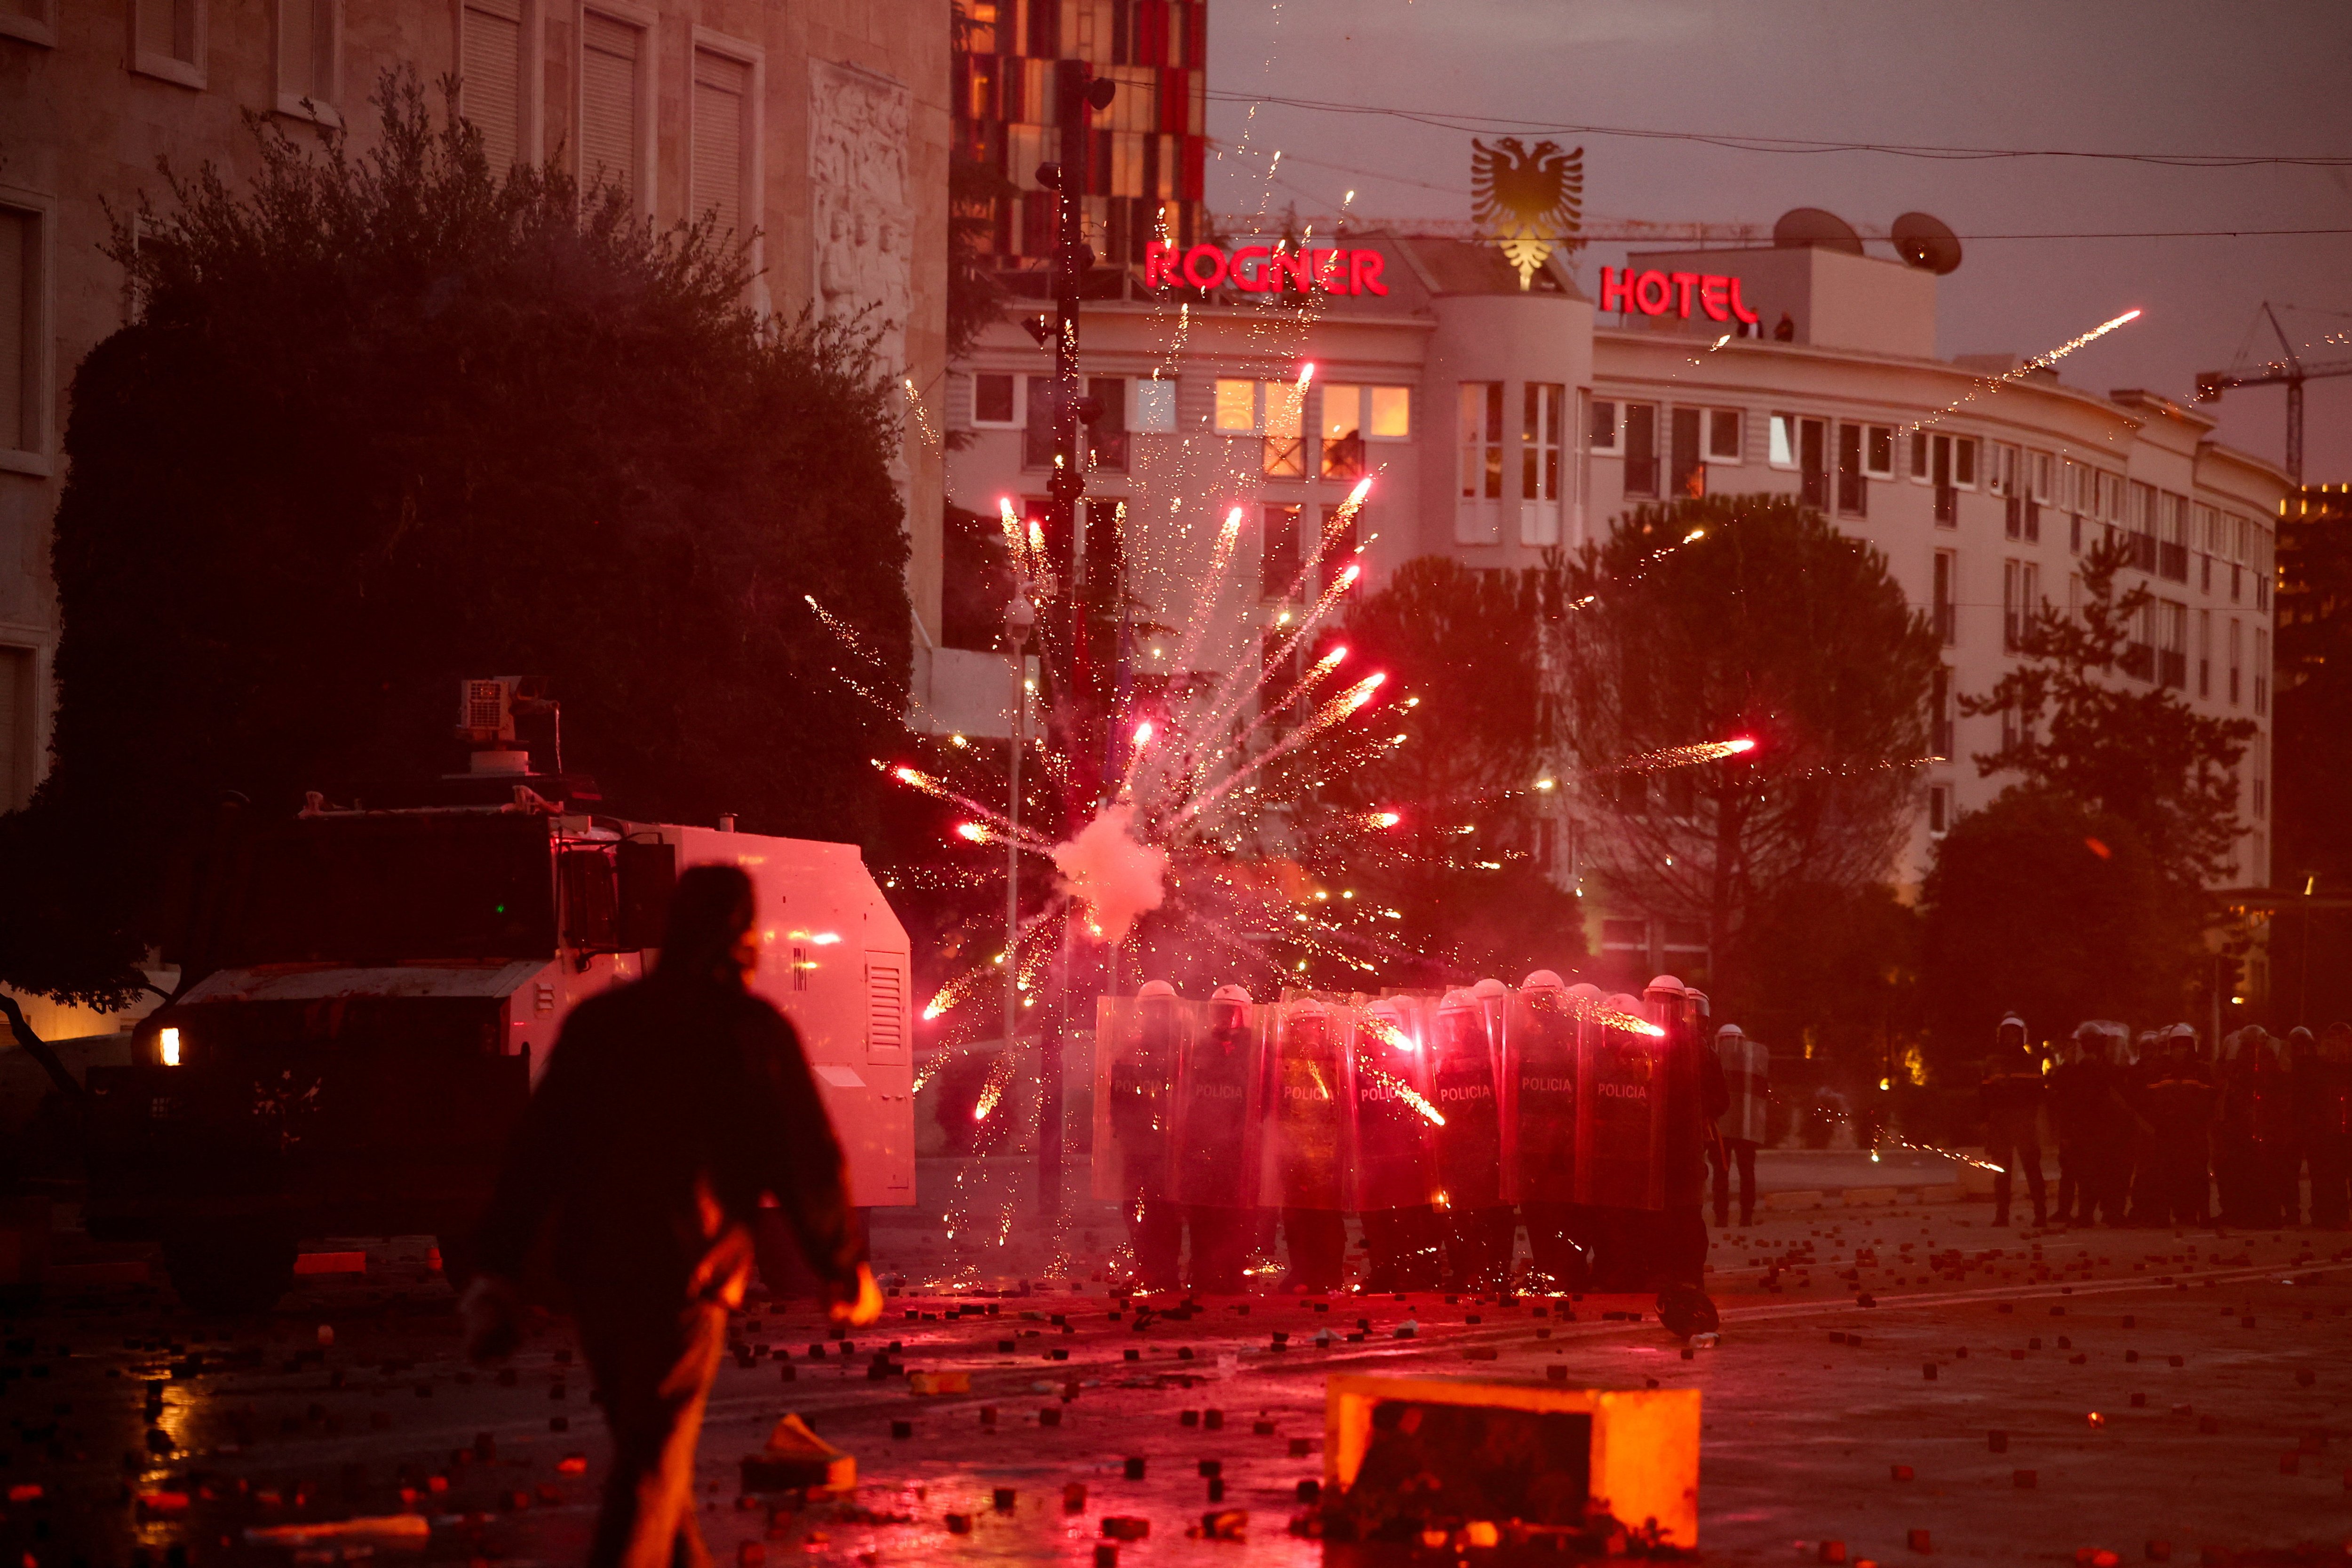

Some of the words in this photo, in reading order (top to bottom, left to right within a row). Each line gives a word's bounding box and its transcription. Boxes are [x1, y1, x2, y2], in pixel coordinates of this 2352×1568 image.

[1145, 241, 1389, 296] ROGNER
[1601, 266, 1759, 324] HOTEL
[1195, 1083, 1243, 1098] POLICIA
[1522, 1077, 1572, 1092] POLICIA
[1598, 1083, 1646, 1099] POLICIA
[1284, 1086, 1334, 1101] POLICA
[1440, 1085, 1491, 1102] POLICIA
